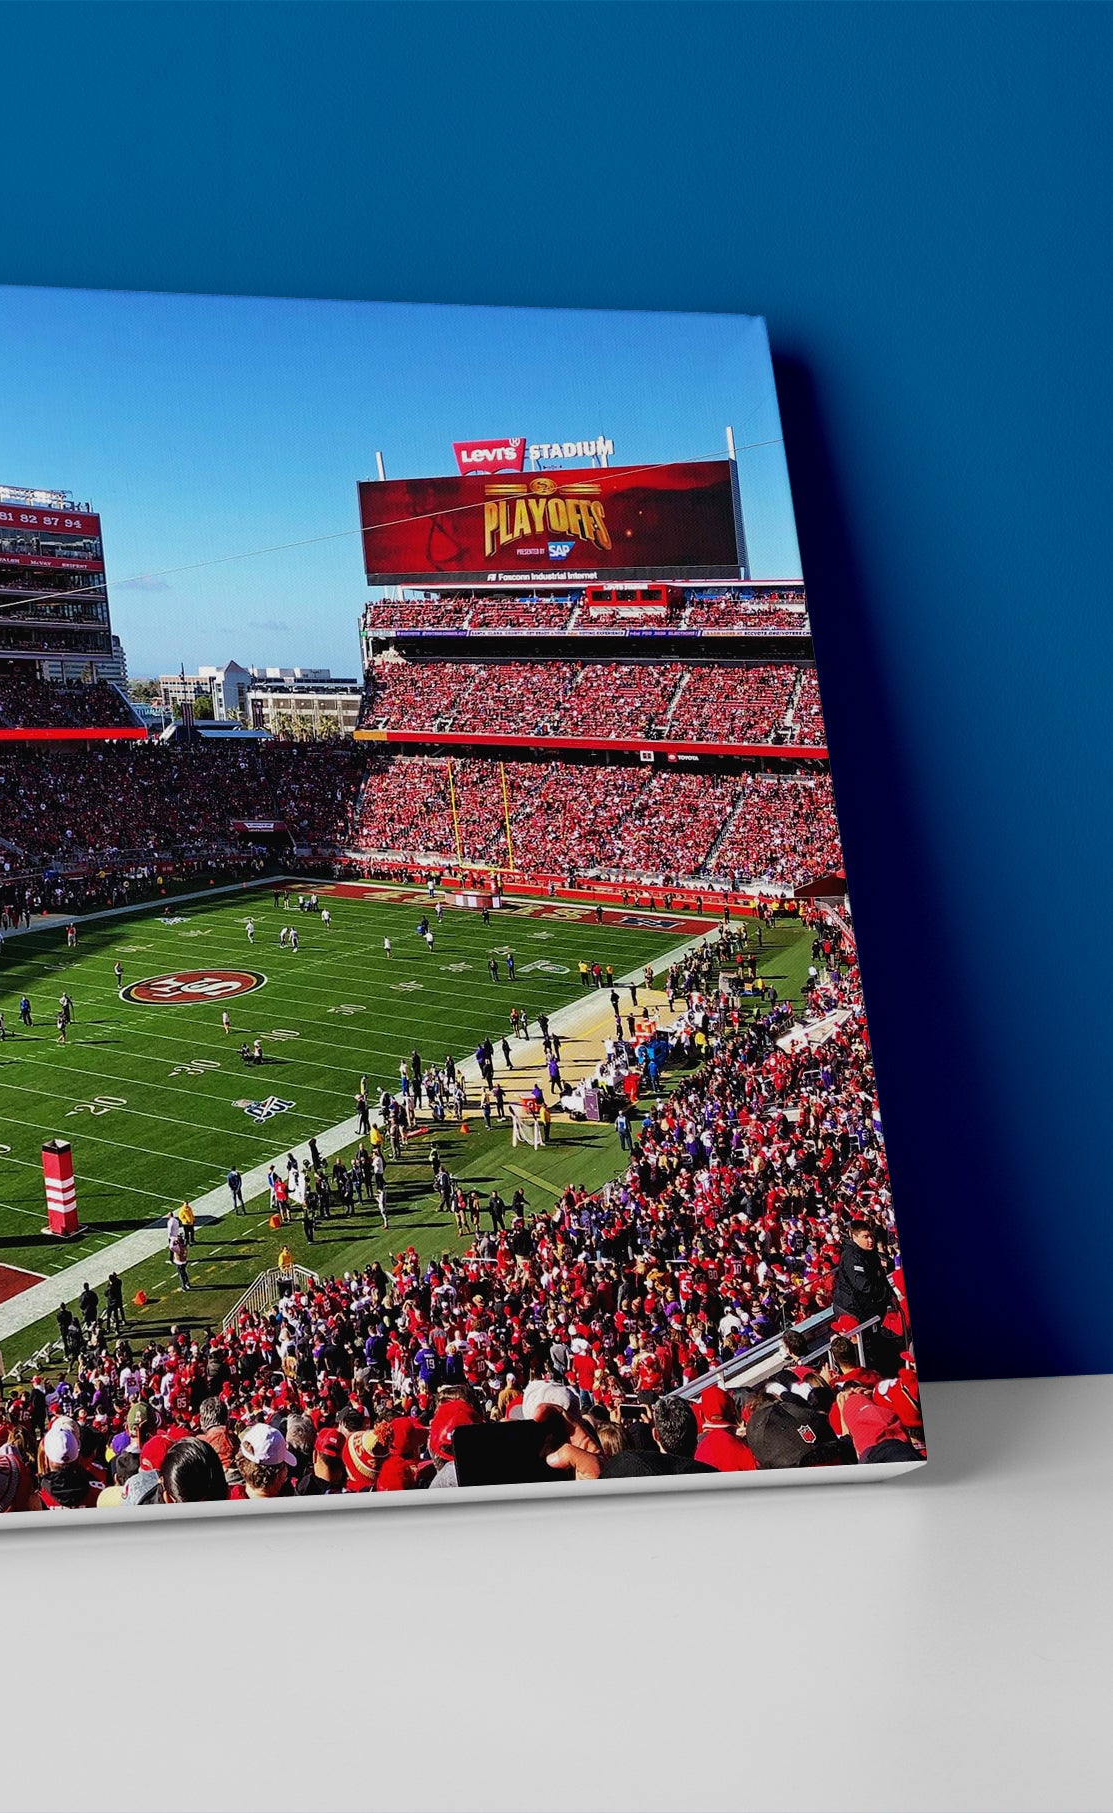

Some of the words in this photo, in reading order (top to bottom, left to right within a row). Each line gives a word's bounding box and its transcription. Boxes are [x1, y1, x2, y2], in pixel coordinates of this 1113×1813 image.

[529, 440, 615, 461] STADIUM
[20, 514, 38, 524] 82
[43, 517, 60, 527] 87
[64, 519, 83, 529] 94
[484, 498, 613, 558] PLAYOFFS
[516, 548, 539, 556] PRESENTED
[548, 545, 571, 557] SAP
[498, 573, 530, 581] Foxconn
[531, 571, 567, 580] Industrial
[567, 571, 598, 580] Internet
[173, 1059, 221, 1076] 30
[73, 1095, 128, 1117] 20
[425, 1358, 436, 1370] 19
[177, 1397, 187, 1409] 85
